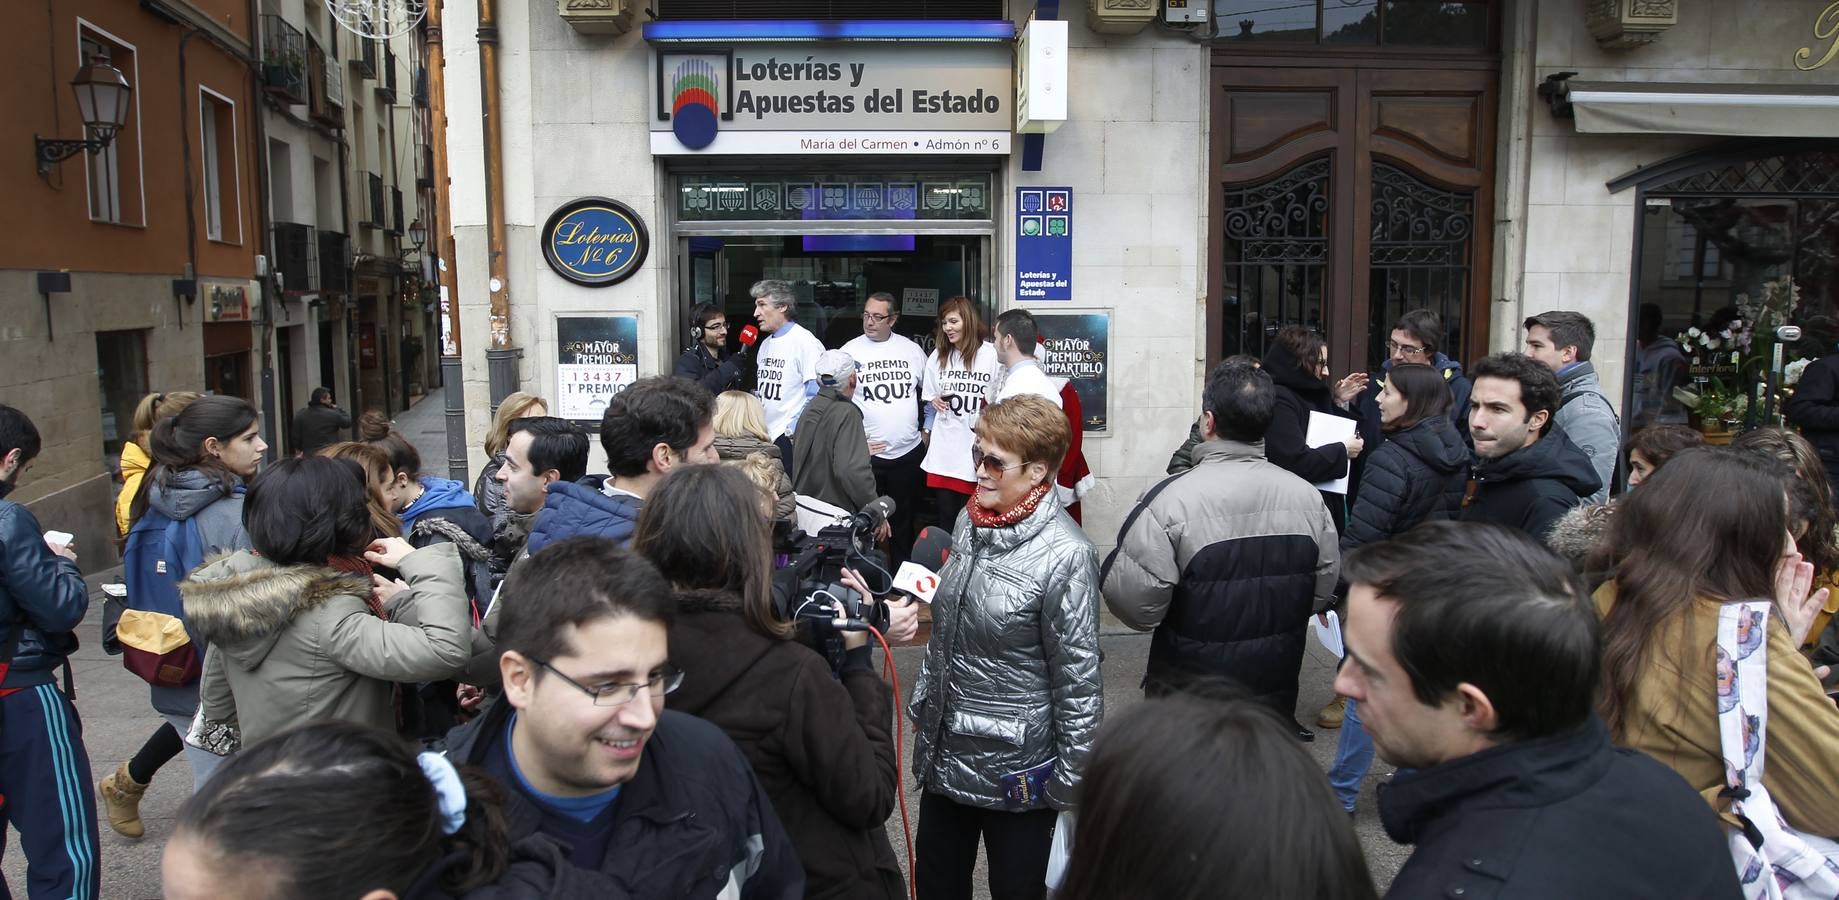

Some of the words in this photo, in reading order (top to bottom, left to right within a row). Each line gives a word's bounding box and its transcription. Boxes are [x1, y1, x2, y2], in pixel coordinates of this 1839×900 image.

[736, 56, 841, 81] Loterías
[850, 63, 865, 88] y
[735, 90, 855, 119] Apuestas
[864, 88, 903, 113] del
[912, 88, 1000, 113] Estado
[800, 139, 835, 150] María
[839, 138, 857, 150] del
[861, 139, 908, 150] Carmen
[926, 139, 970, 150] Admón
[992, 139, 999, 150] 6
[604, 247, 623, 266] 6
[1020, 271, 1051, 279] Loterías
[1020, 280, 1055, 289] Apuestas
[585, 340, 620, 353] MAYOR
[1055, 338, 1090, 351] MAYOR
[576, 354, 613, 364] PREMIO
[1046, 351, 1082, 362] PREMIO
[868, 360, 909, 371] PREMIO
[858, 371, 912, 384] VENDIDO
[948, 371, 991, 382] PREMIO
[578, 384, 627, 393] PREMIO
